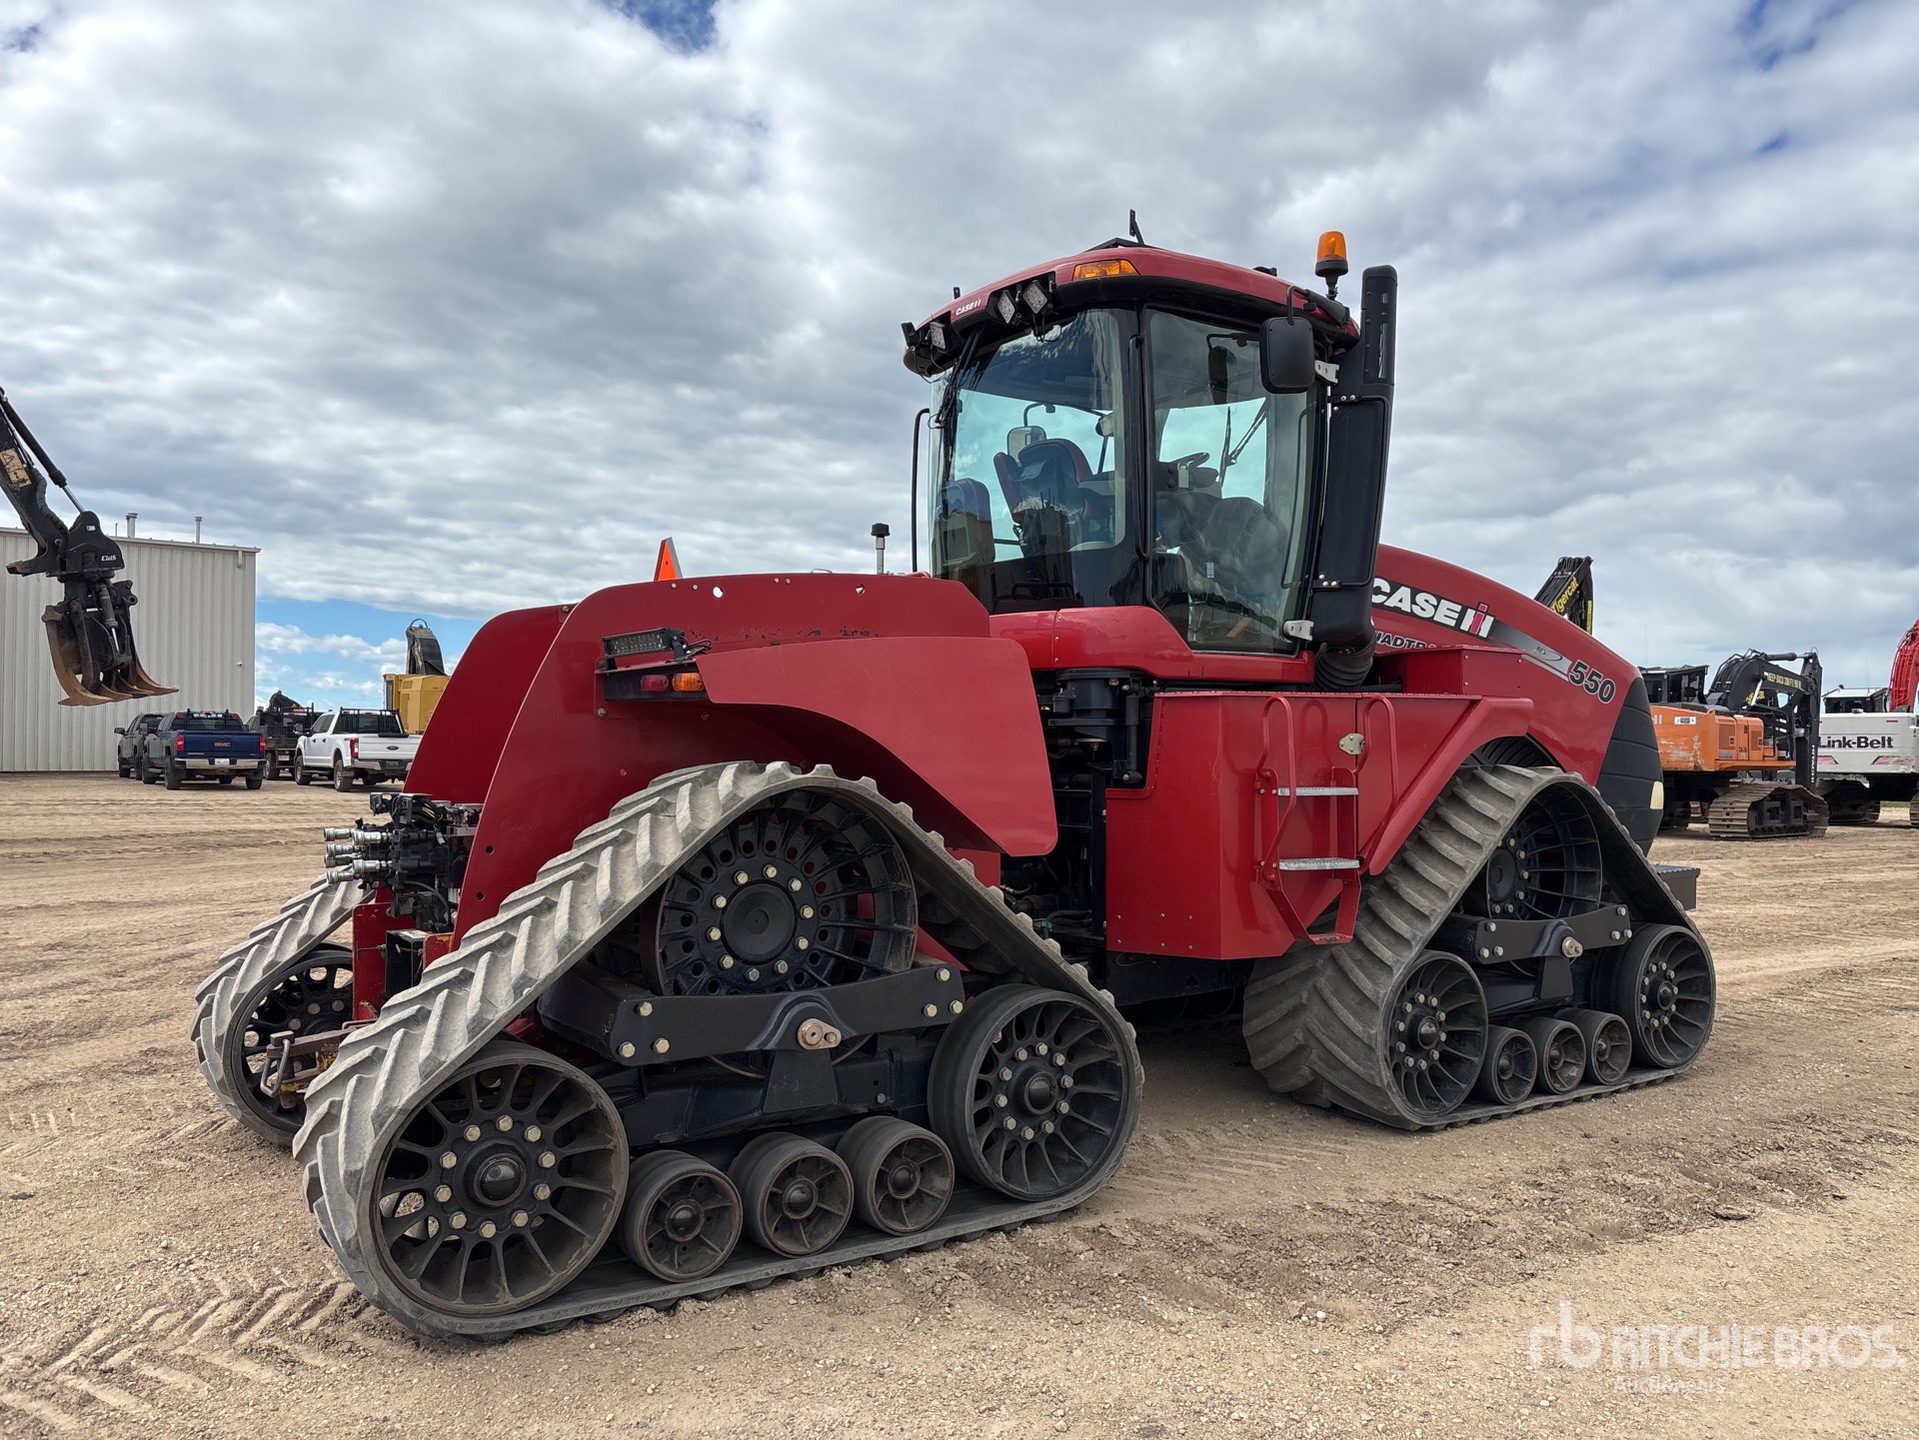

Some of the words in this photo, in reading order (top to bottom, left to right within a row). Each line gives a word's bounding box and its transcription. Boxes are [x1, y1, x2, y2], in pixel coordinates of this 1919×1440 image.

[1371, 577, 1462, 627] CASE
[1551, 576, 1579, 613] Tigercat
[1568, 660, 1616, 704] 550
[1818, 736, 1894, 749] Link-Belt
